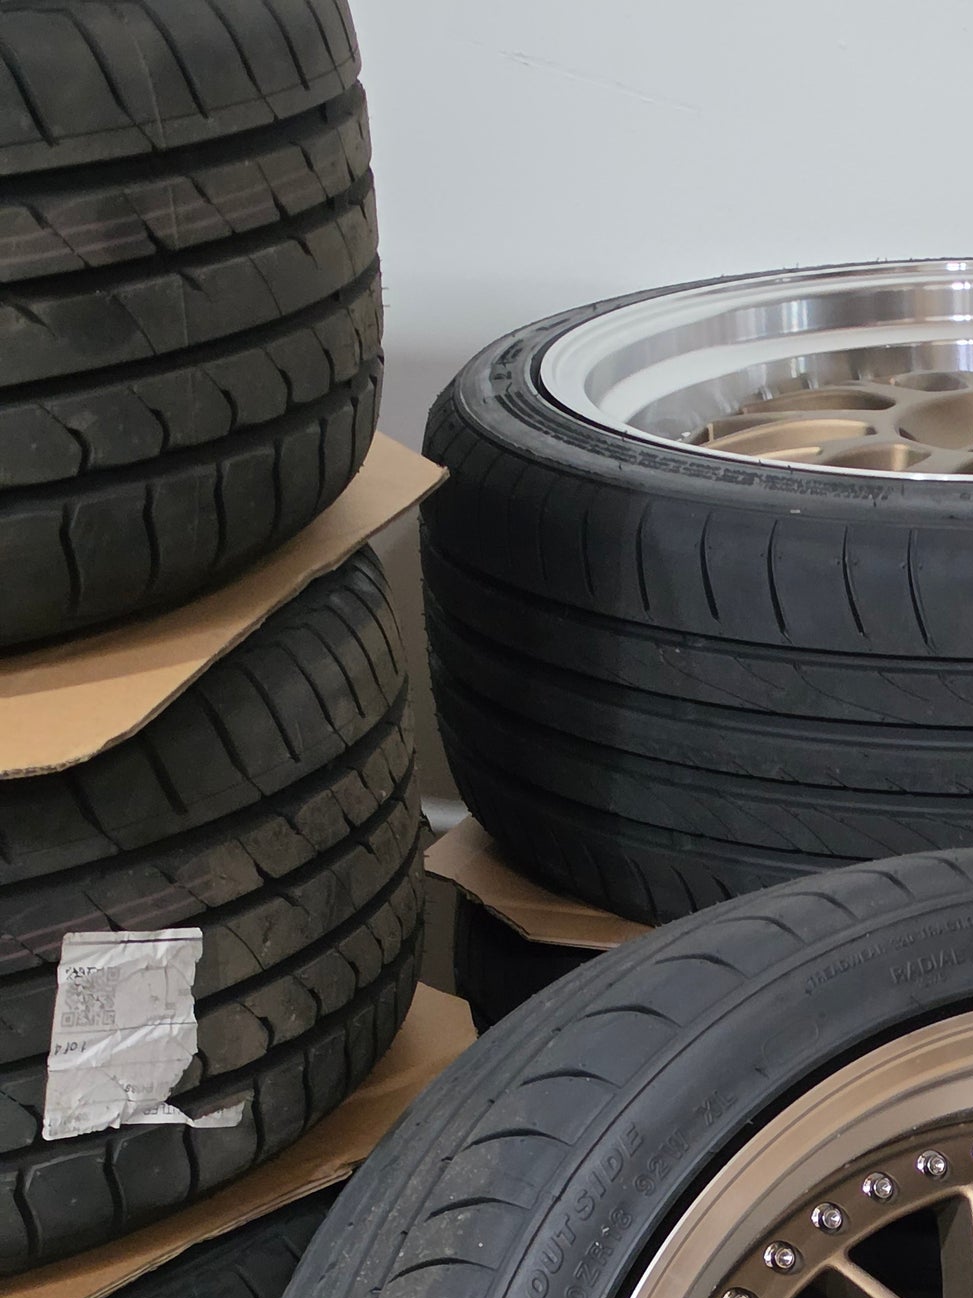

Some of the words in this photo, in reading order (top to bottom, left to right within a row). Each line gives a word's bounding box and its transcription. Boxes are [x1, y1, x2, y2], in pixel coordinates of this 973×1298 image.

[888, 951, 967, 985] RADIAL
[633, 1128, 691, 1197] 92W
[694, 1089, 737, 1127] XL
